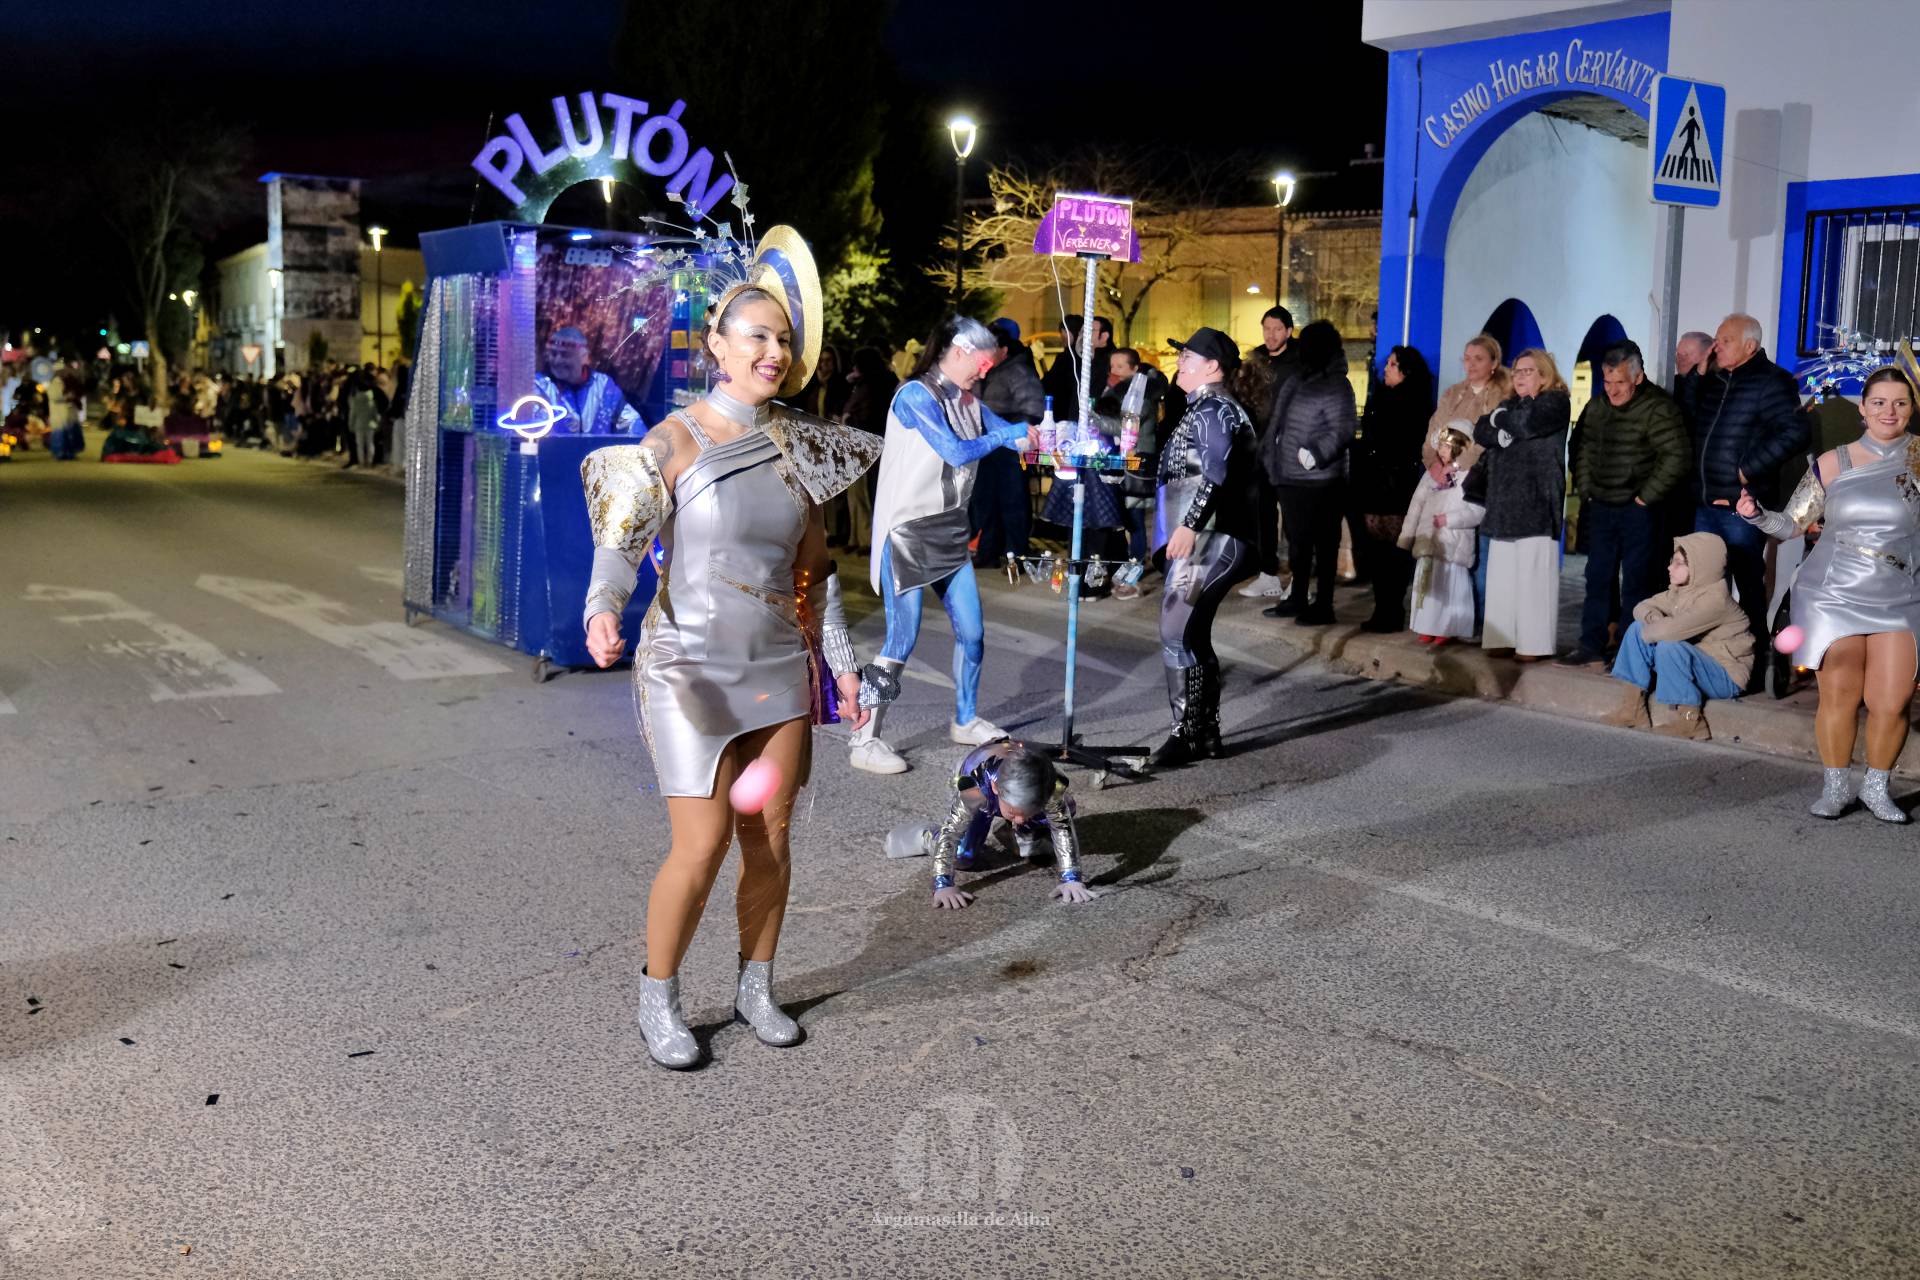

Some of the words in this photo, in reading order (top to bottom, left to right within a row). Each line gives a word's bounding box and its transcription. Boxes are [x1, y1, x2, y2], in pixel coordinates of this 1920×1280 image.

[473, 91, 735, 221] PLUTÓN
[1425, 83, 1490, 148] CASINO
[1488, 51, 1559, 104] HOGAR
